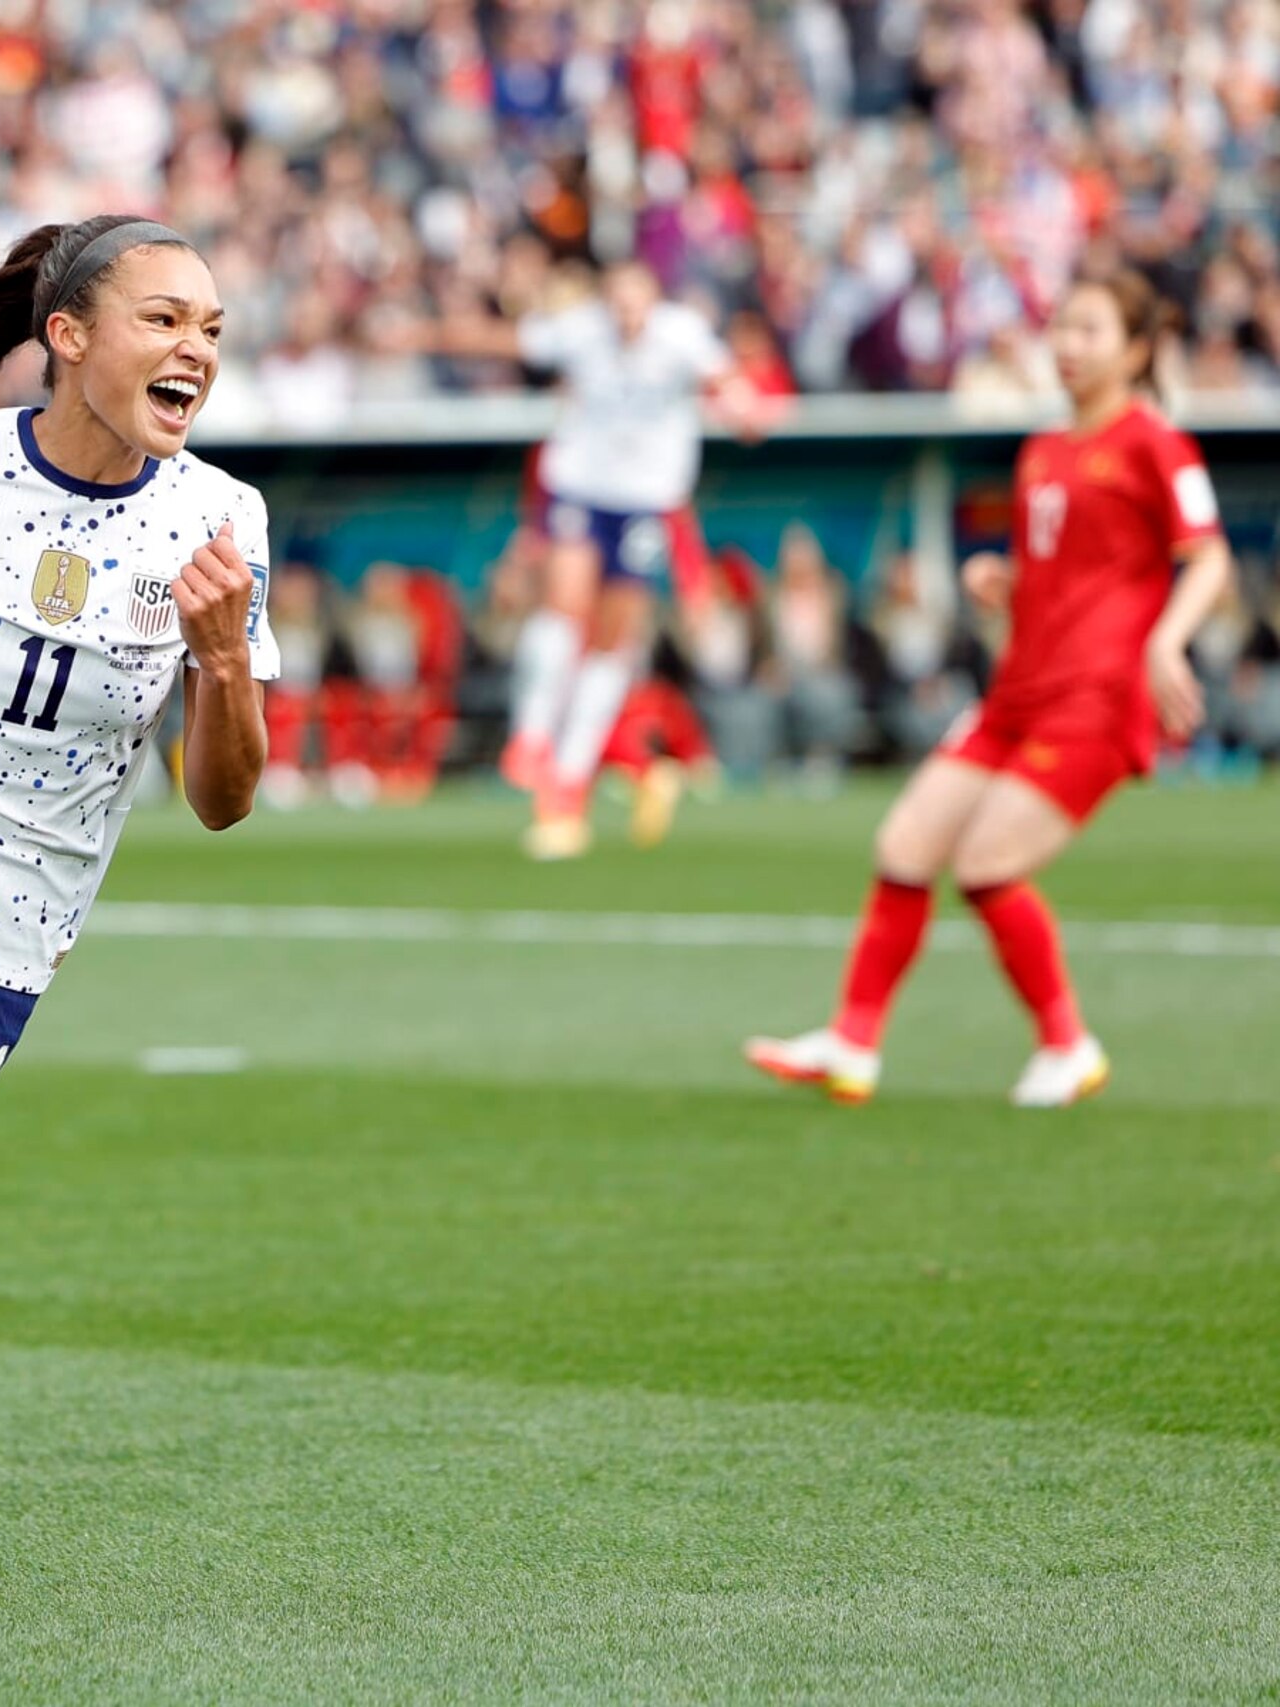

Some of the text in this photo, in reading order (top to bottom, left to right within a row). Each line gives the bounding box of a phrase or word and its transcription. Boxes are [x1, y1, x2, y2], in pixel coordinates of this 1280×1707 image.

[45, 596, 69, 610] FIFA
[134, 577, 173, 605] USA
[0, 635, 78, 732] 11
